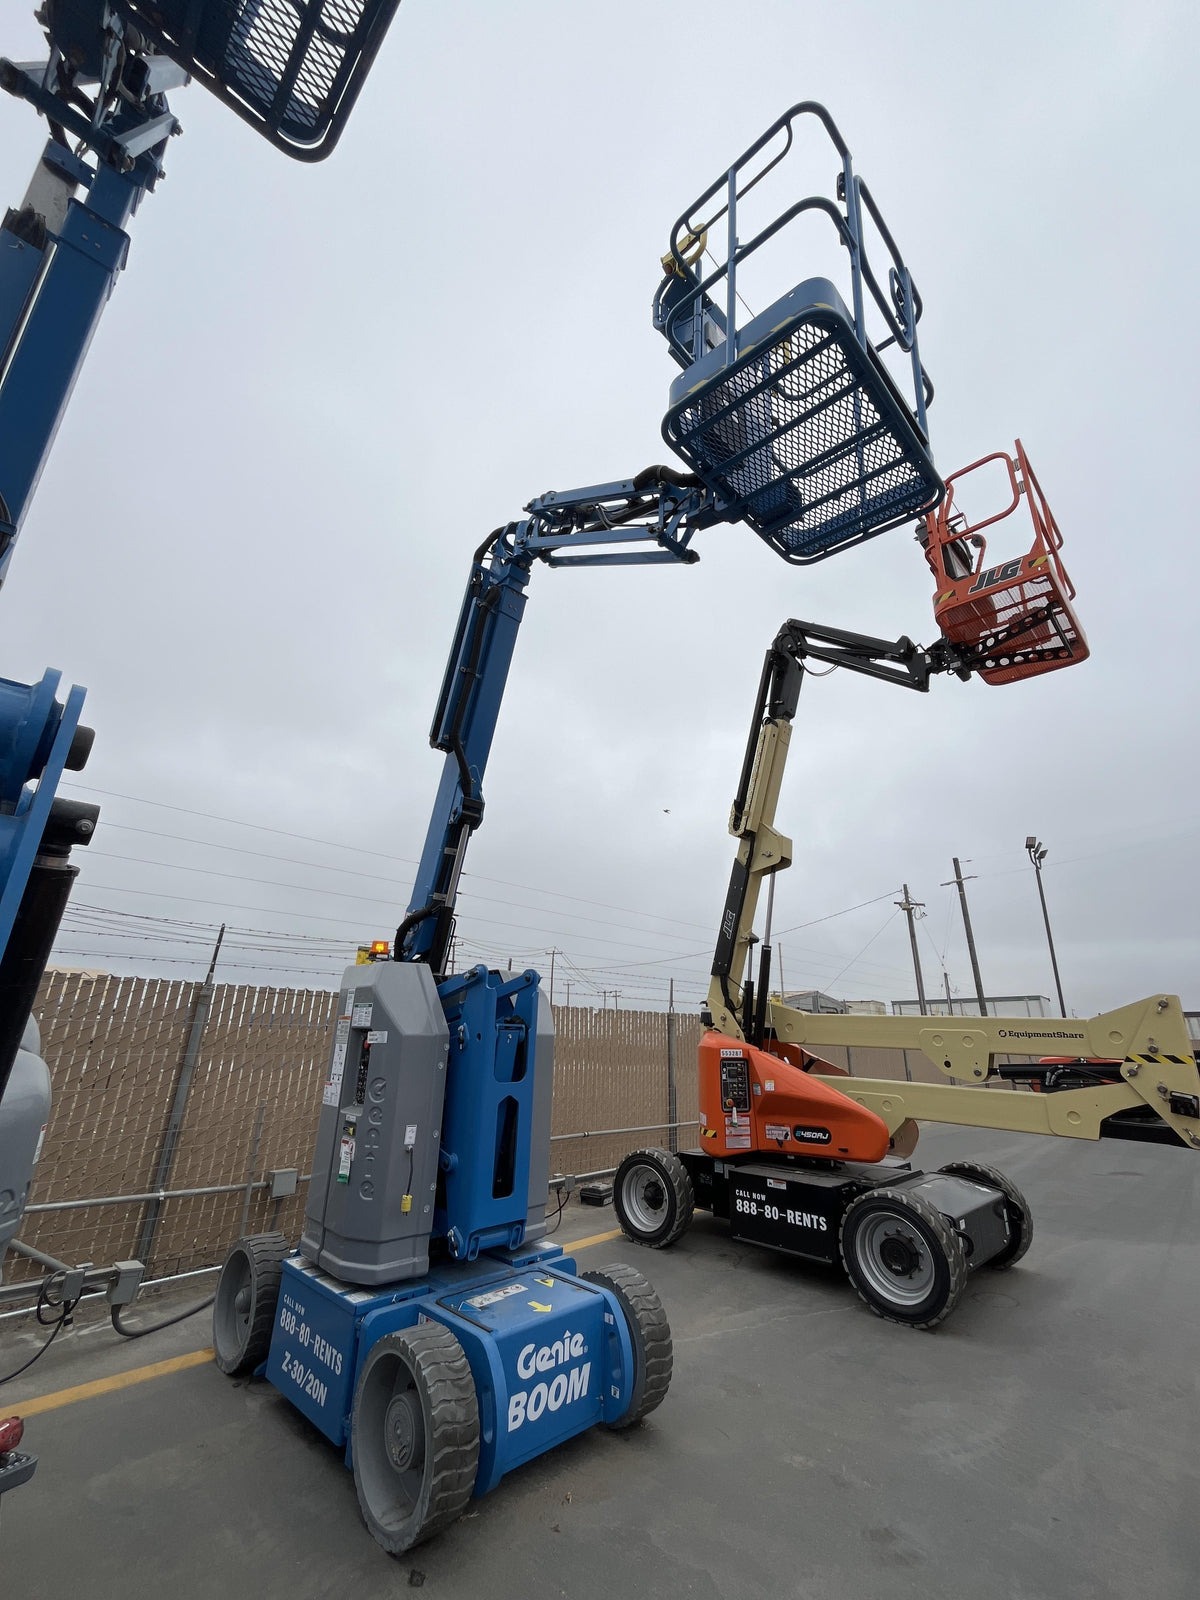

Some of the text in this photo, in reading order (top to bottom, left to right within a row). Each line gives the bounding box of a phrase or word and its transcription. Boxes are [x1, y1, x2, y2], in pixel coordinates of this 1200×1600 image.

[968, 558, 1023, 595] JLG
[722, 909, 736, 940] JLG
[1008, 1030, 1085, 1039] EquipmentShare
[735, 1189, 766, 1201] CALL NOW
[736, 1199, 827, 1231] 888-80-RENTS
[283, 1294, 305, 1316] CALL NOW
[280, 1308, 343, 1375] 888-80-RENTS
[517, 1330, 584, 1380] Genie
[508, 1362, 591, 1432] BOOM
